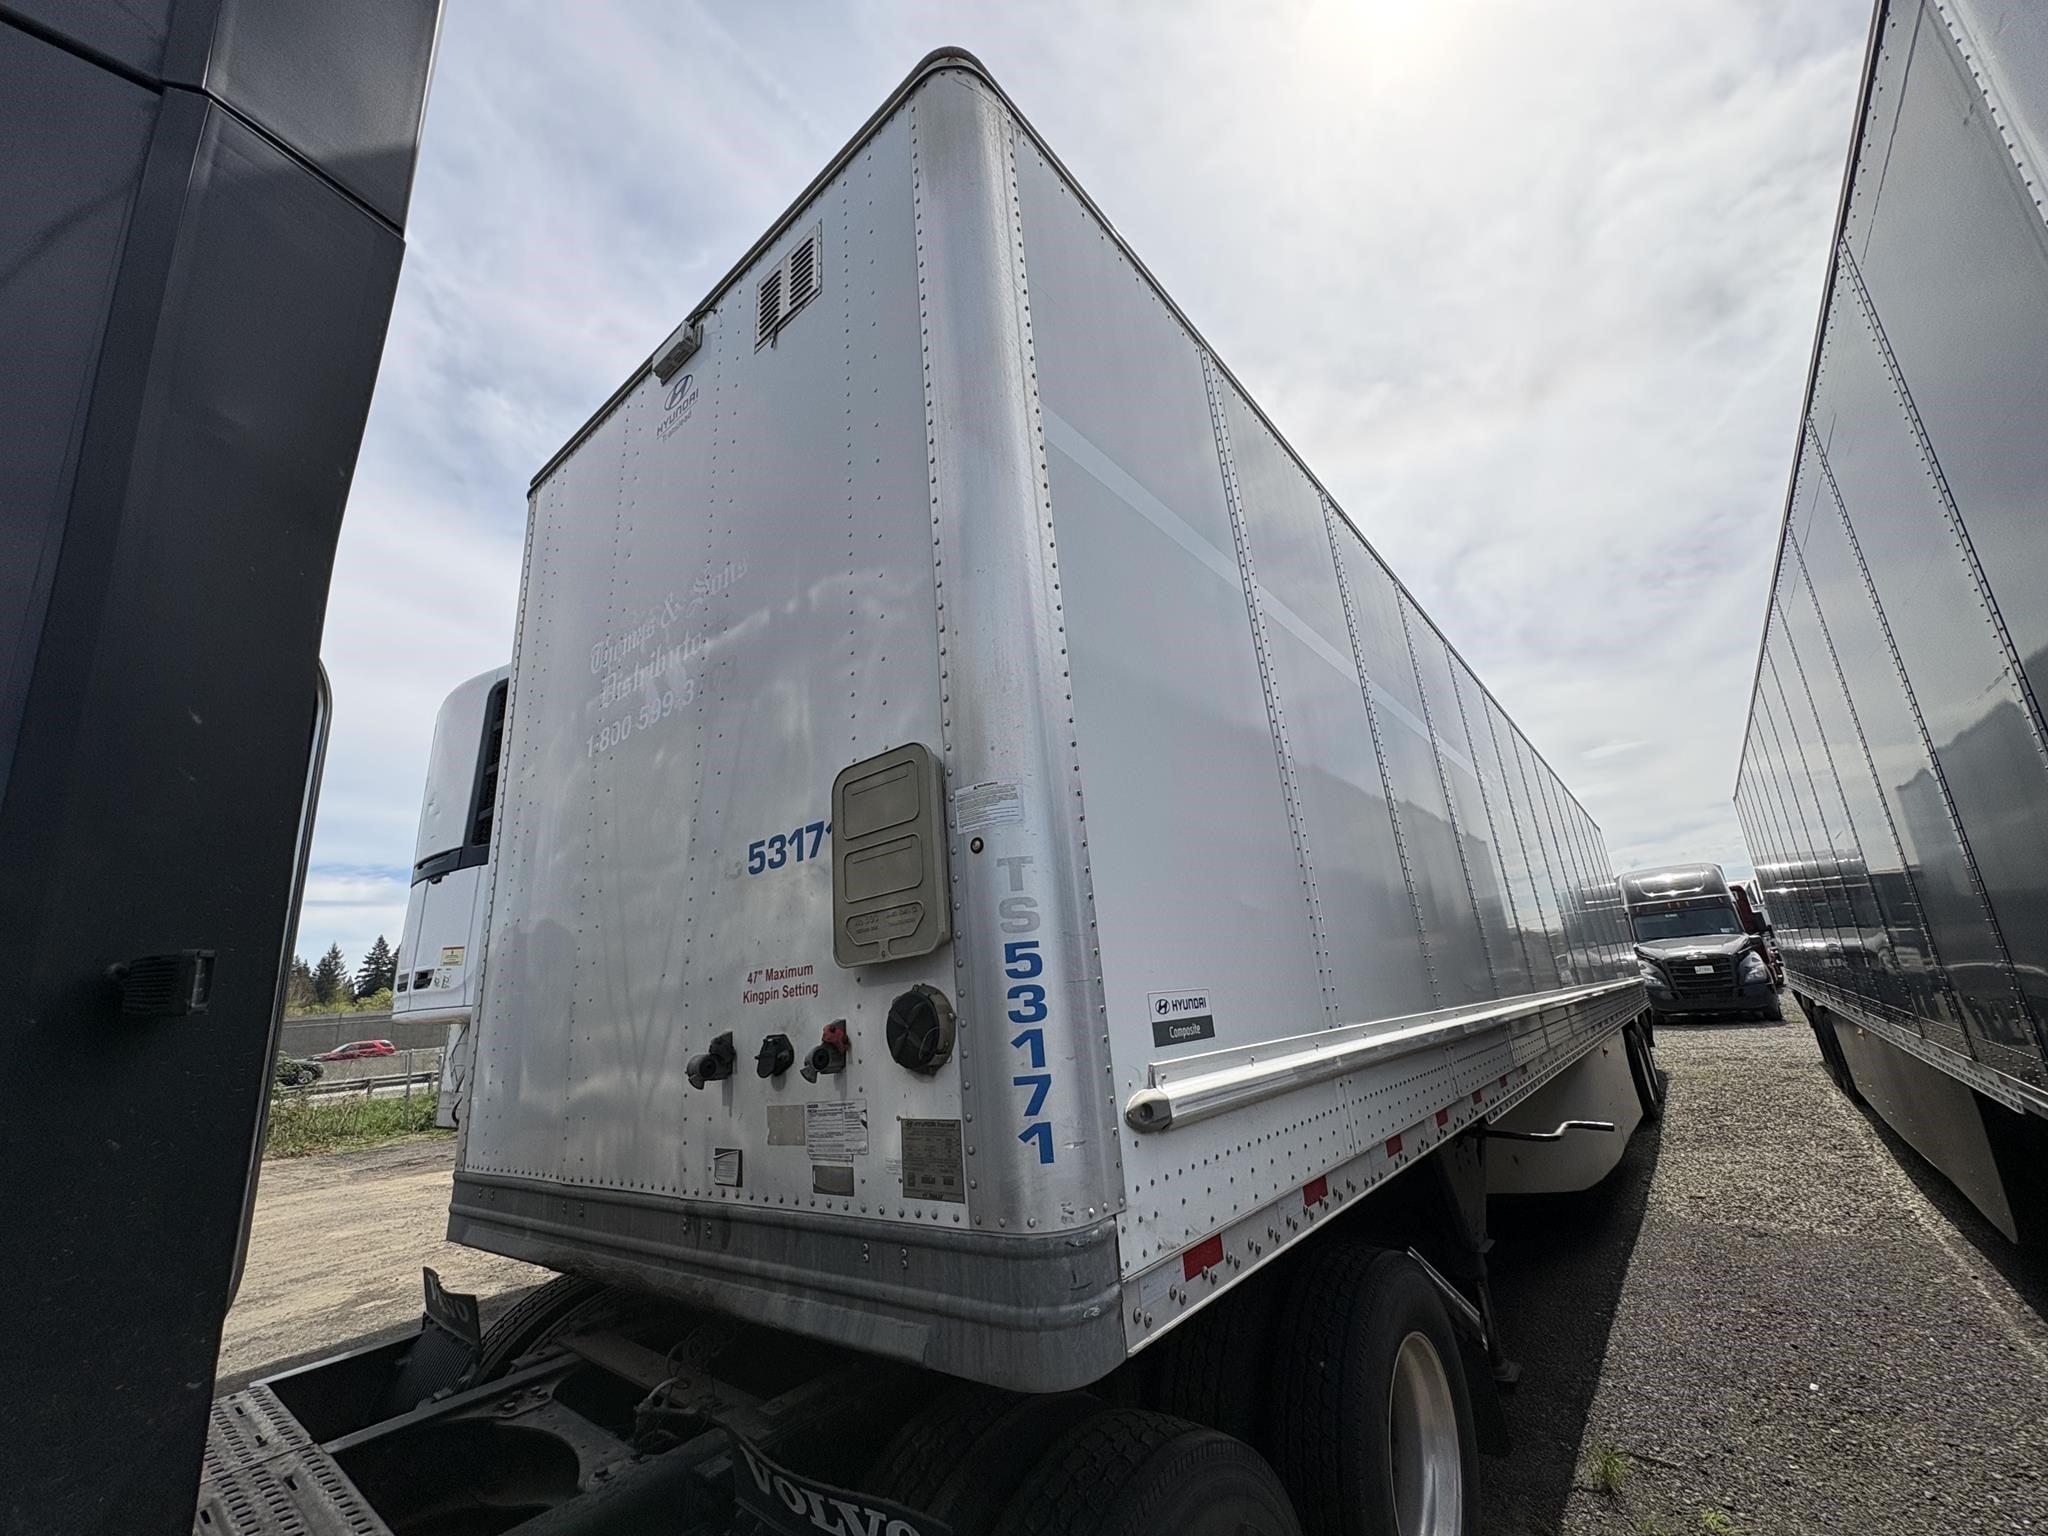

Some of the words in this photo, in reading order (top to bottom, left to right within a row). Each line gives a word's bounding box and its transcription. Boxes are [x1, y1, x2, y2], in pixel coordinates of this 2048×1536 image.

[656, 387, 699, 436] HYUNDAI
[748, 820, 833, 875] 5317
[747, 970, 763, 985] 47"
[765, 964, 814, 982] Maximum
[743, 987, 780, 1005] Kingpin
[782, 982, 819, 998] Setting
[1171, 997, 1207, 1012] HYUNDAI
[1169, 1023, 1201, 1039] Composite
